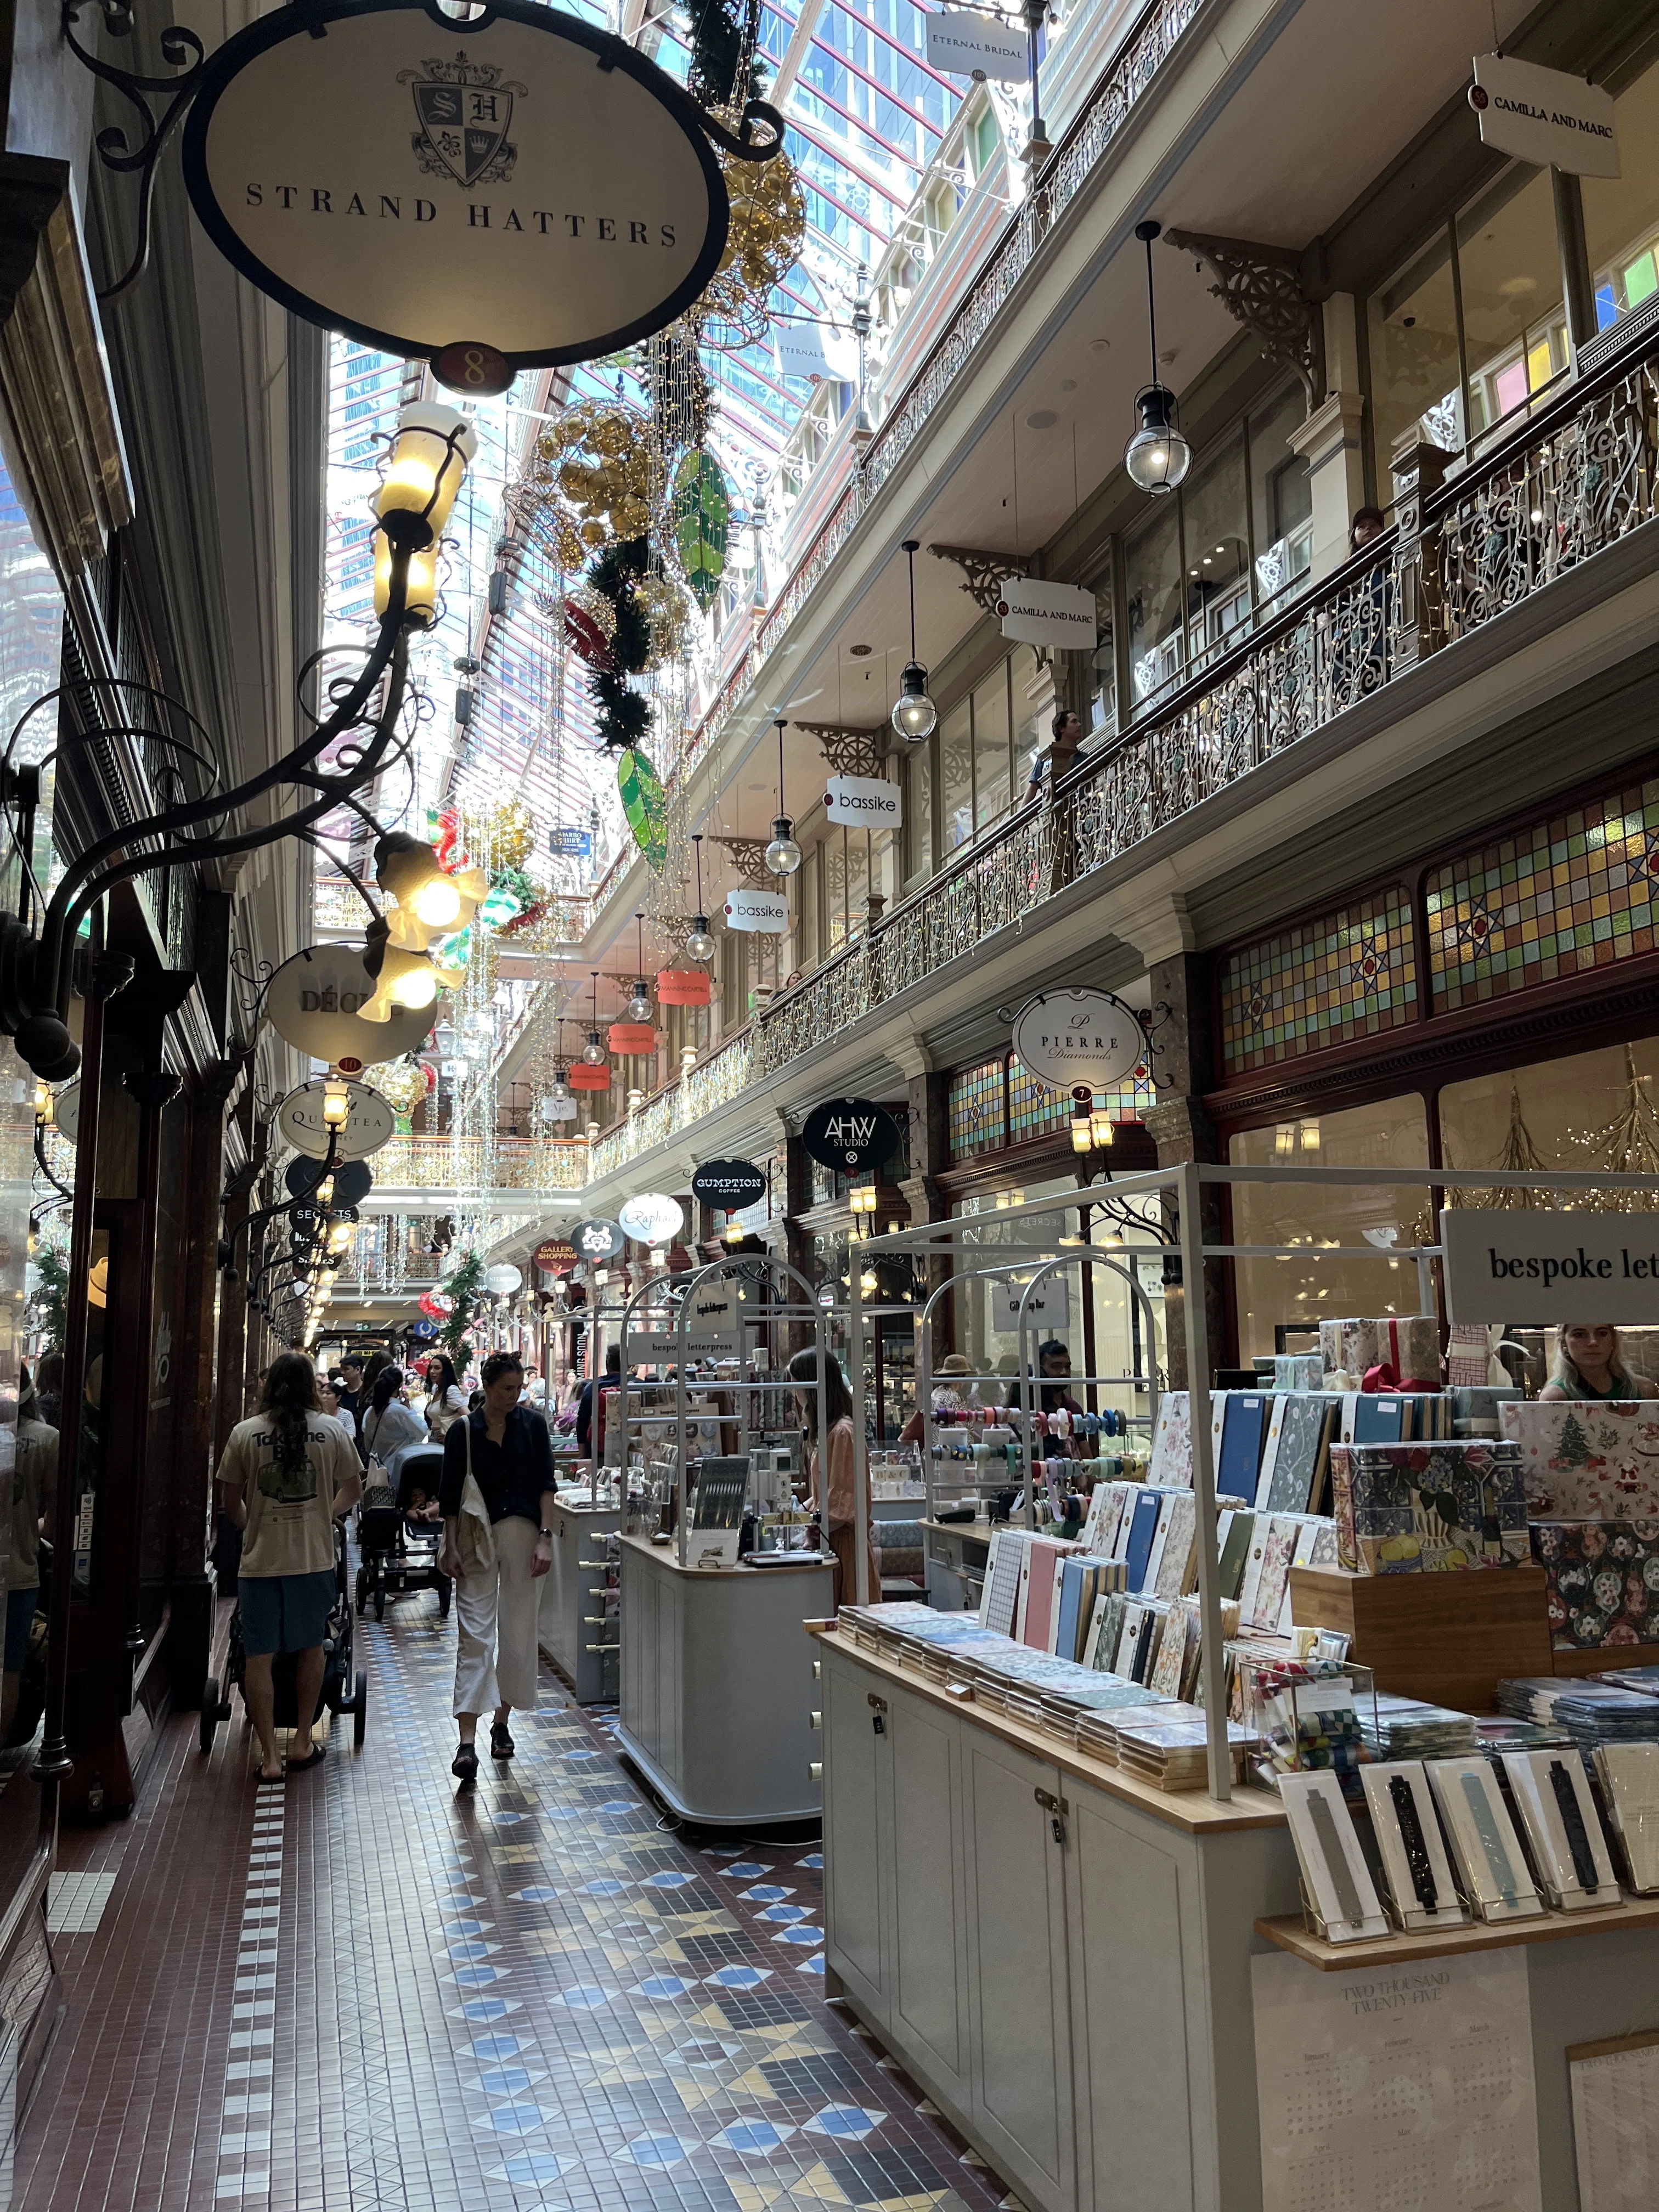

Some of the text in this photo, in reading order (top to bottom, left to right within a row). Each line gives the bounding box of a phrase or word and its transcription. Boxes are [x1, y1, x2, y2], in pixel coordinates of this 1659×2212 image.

[933, 35, 1023, 59] ETERNAL BRIDAL
[1494, 97, 1613, 138] CAMILLA AND MARC
[246, 183, 677, 248] STRAND HATTERS
[780, 346, 819, 357] ETERNAL
[464, 349, 486, 385] 8
[1012, 606, 1092, 624] CAMILLA AND MARC
[840, 793, 896, 811] bassike
[737, 904, 783, 918] bassike
[1041, 1036, 1118, 1048] PIERRE
[1047, 1047, 1112, 1060] Diamonds
[345, 1058, 357, 1070] 10
[1079, 1090, 1085, 1098] 7
[292, 1111, 382, 1132] QUATEA
[824, 1116, 877, 1139] AHW
[833, 1138, 868, 1147] STUDIO
[696, 1179, 761, 1187] GUMPTION
[297, 1210, 351, 1219] SECTS
[1488, 1248, 1613, 1288] bespoke
[687, 1343, 732, 1352] letterpress
[1341, 1972, 1451, 2001] TWO THOUSAND
[1351, 1987, 1442, 2015] TWENTY-FIVE
